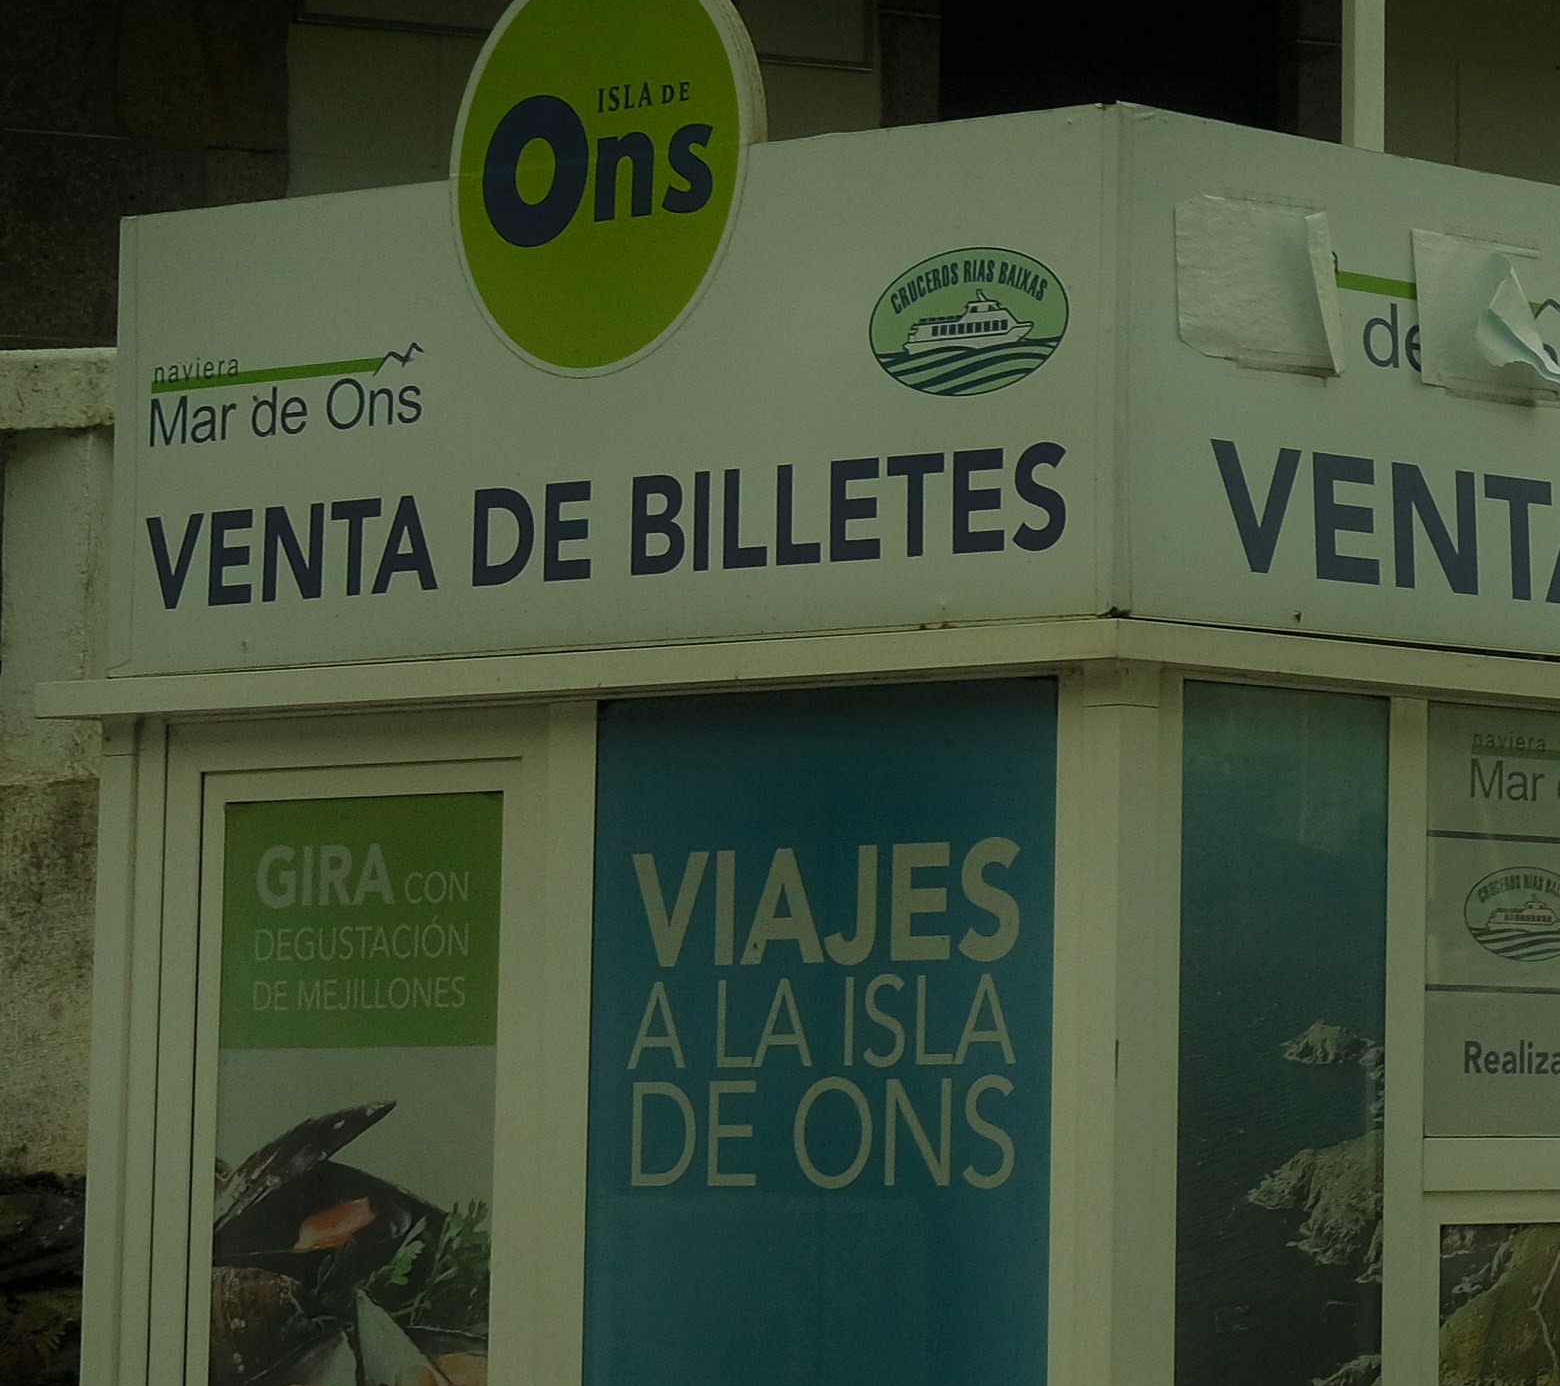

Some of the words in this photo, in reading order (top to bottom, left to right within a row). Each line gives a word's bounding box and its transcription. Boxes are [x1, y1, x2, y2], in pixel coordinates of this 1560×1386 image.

[597, 82, 653, 114] ISLA
[660, 80, 692, 106] DE
[482, 94, 714, 248] Ons
[149, 397, 231, 448] Mar
[250, 384, 308, 439] de
[324, 378, 424, 433] Ons
[152, 354, 242, 387] naviera
[145, 495, 439, 611] VENTA
[471, 479, 593, 588] DE
[630, 441, 1069, 576] BILLETES
[631, 835, 1022, 969] VIAJES
[627, 979, 687, 1071] A
[714, 978, 813, 1070] LA
[842, 971, 1017, 1069] ISLA
[629, 1079, 758, 1189] DE
[792, 1073, 1016, 1190] ONS
